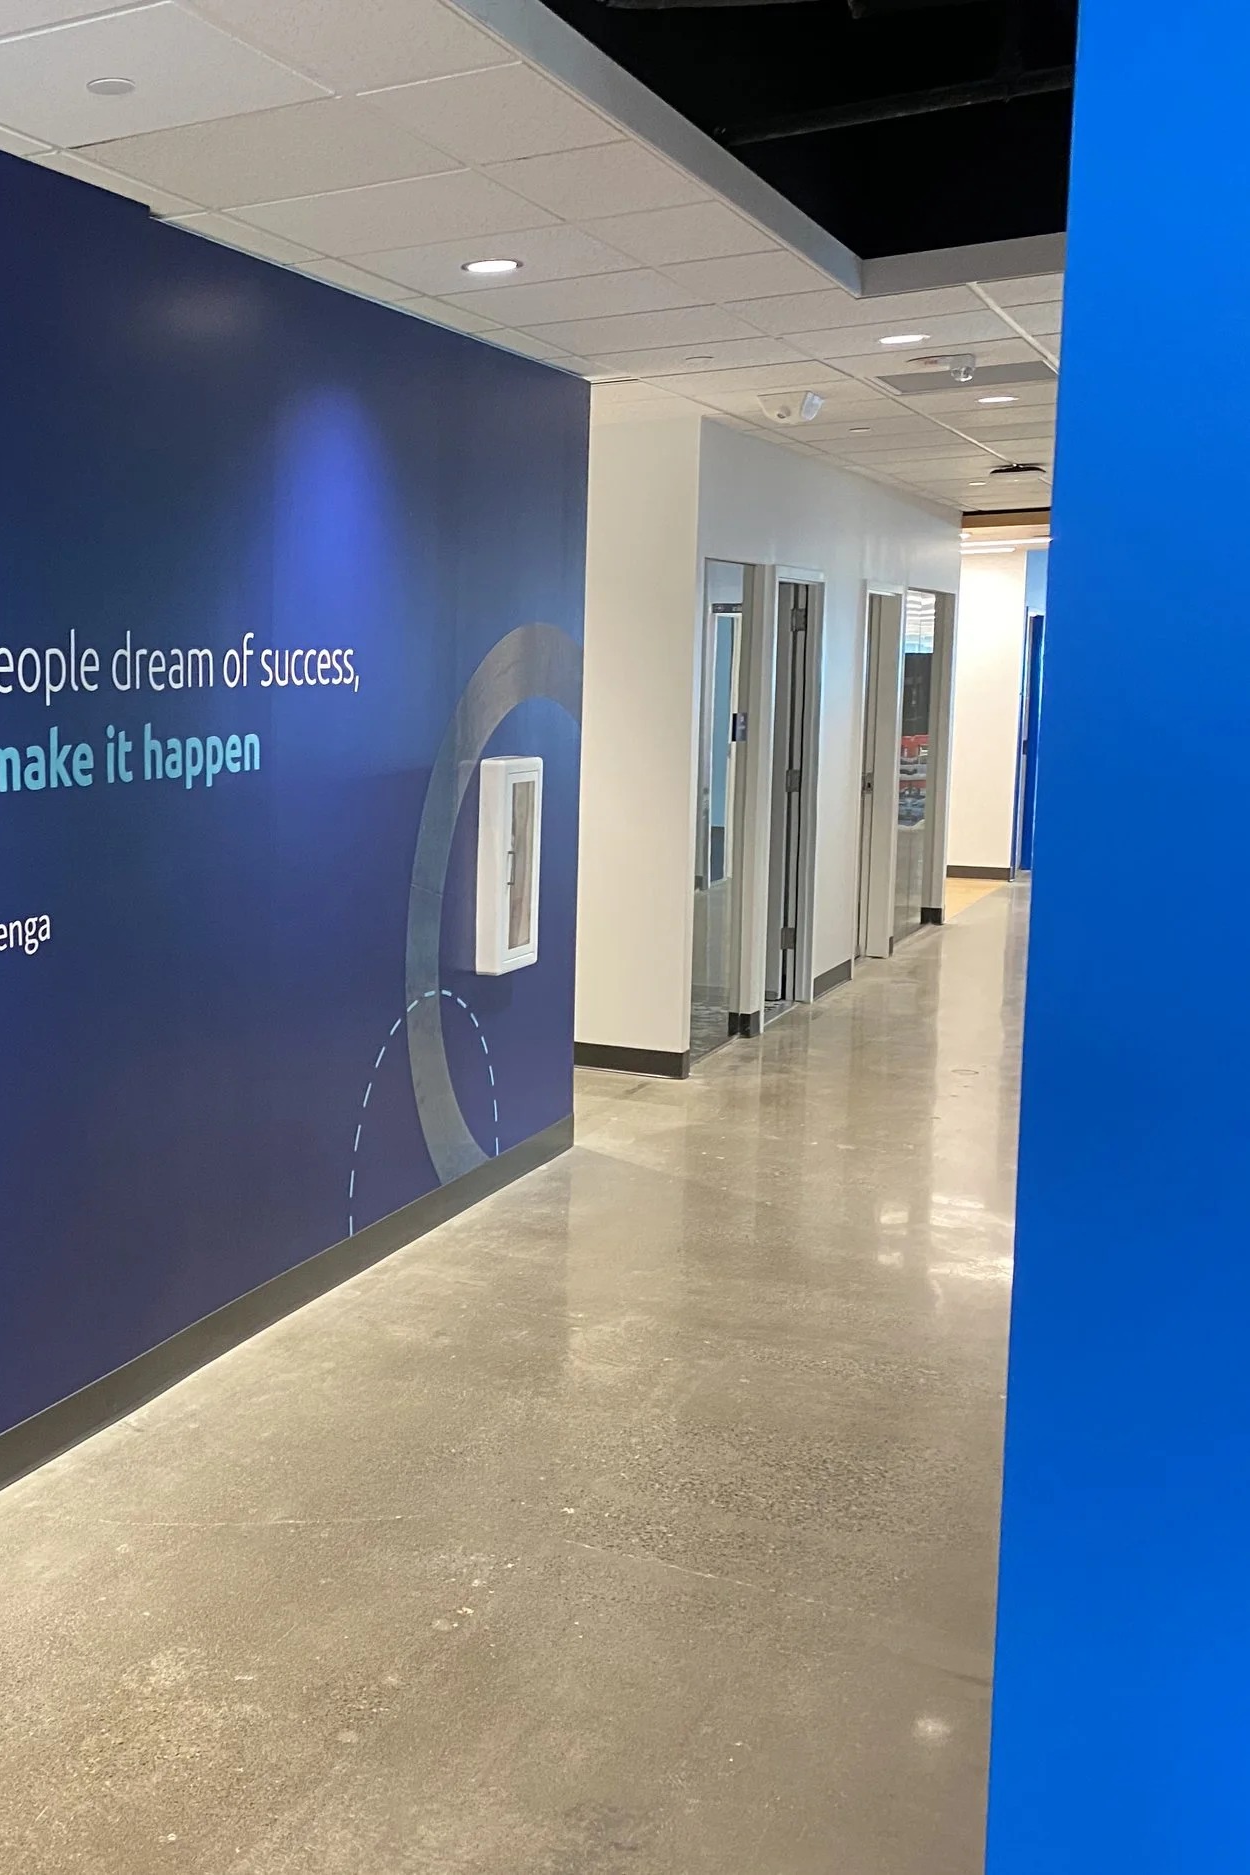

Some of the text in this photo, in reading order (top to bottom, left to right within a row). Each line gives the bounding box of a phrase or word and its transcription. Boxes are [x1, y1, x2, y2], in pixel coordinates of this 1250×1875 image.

[111, 630, 214, 691] dream
[223, 632, 255, 688] of
[260, 647, 360, 693] success,
[106, 724, 134, 784] it
[144, 722, 261, 790] happen
